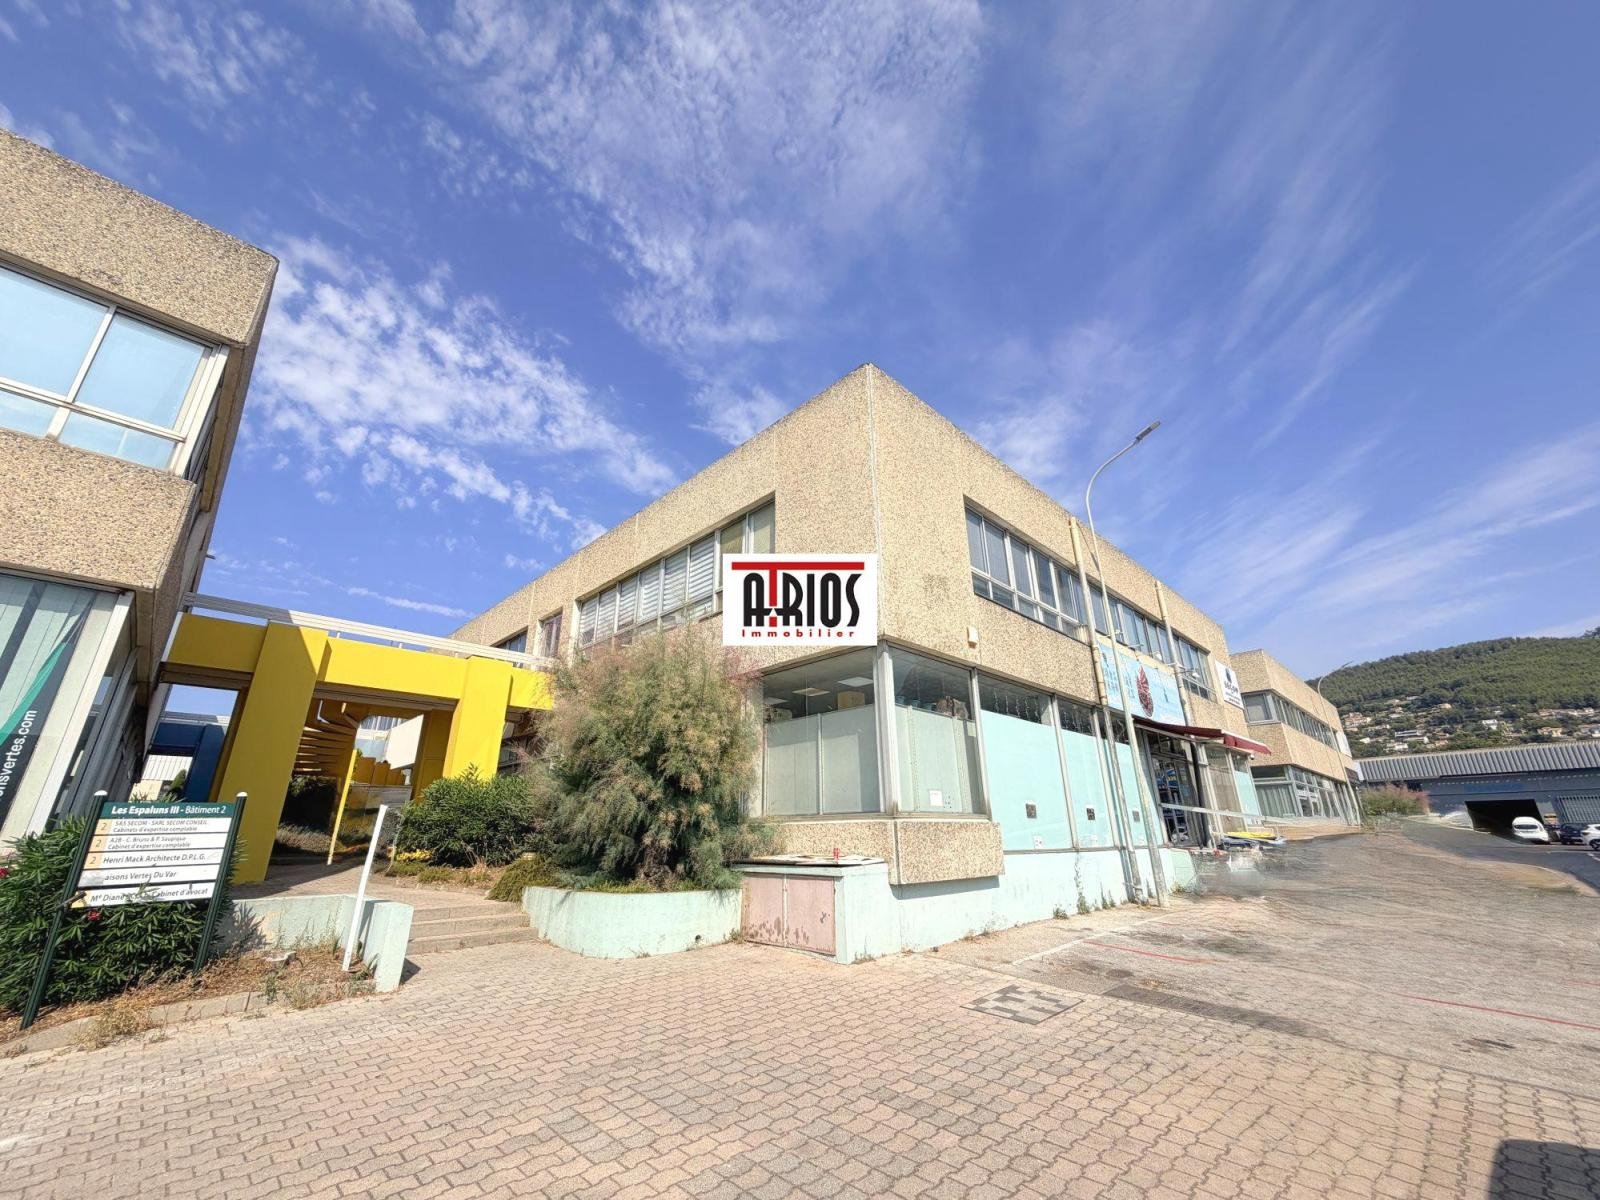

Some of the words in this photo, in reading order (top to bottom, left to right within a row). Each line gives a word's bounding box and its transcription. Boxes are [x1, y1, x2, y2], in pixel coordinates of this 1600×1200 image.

[111, 806, 127, 815] Les
[128, 806, 169, 816] Espaluns
[169, 806, 179, 814] III
[185, 805, 220, 814] Bâtiment
[220, 806, 226, 814] 2
[101, 823, 108, 831] 2
[95, 840, 102, 848] 2
[89, 856, 97, 864] 2
[124, 855, 144, 863] Mack
[144, 854, 181, 862] Architecte
[181, 853, 206, 861] D.P.L.G.
[103, 873, 129, 881] aisons
